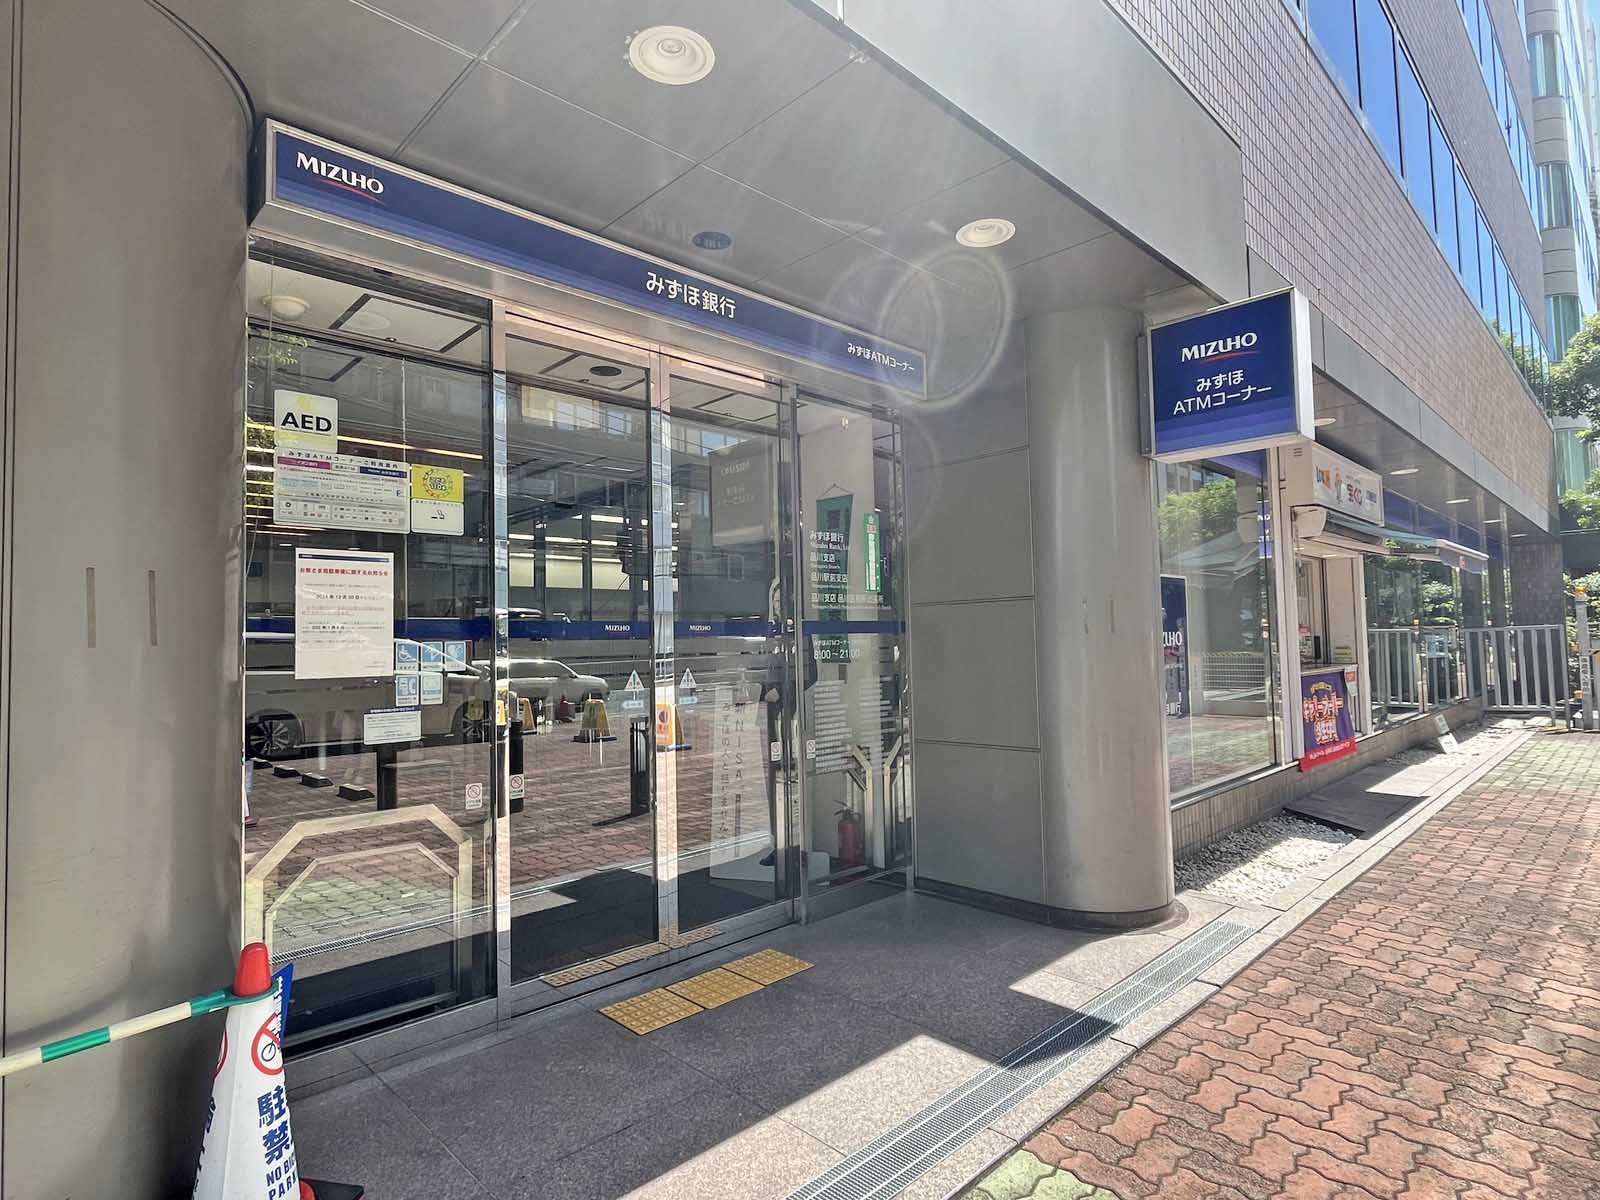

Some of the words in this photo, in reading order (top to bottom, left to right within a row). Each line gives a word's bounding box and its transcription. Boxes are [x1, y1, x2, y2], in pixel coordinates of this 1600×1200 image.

[296, 151, 385, 195] MIZUHO
[645, 271, 737, 319] みずほ銀行
[847, 342, 915, 372] みずほATMコーナー
[1180, 332, 1258, 363] MIZUHO
[1196, 369, 1245, 393] みずほ
[1173, 385, 1272, 415] ATMコーナー
[280, 411, 332, 433] AED
[810, 531, 844, 543] みずほ銀行
[604, 624, 631, 632] MIZUHO
[688, 624, 712, 632] MIZUHO
[266, 1166, 282, 1187] NO
